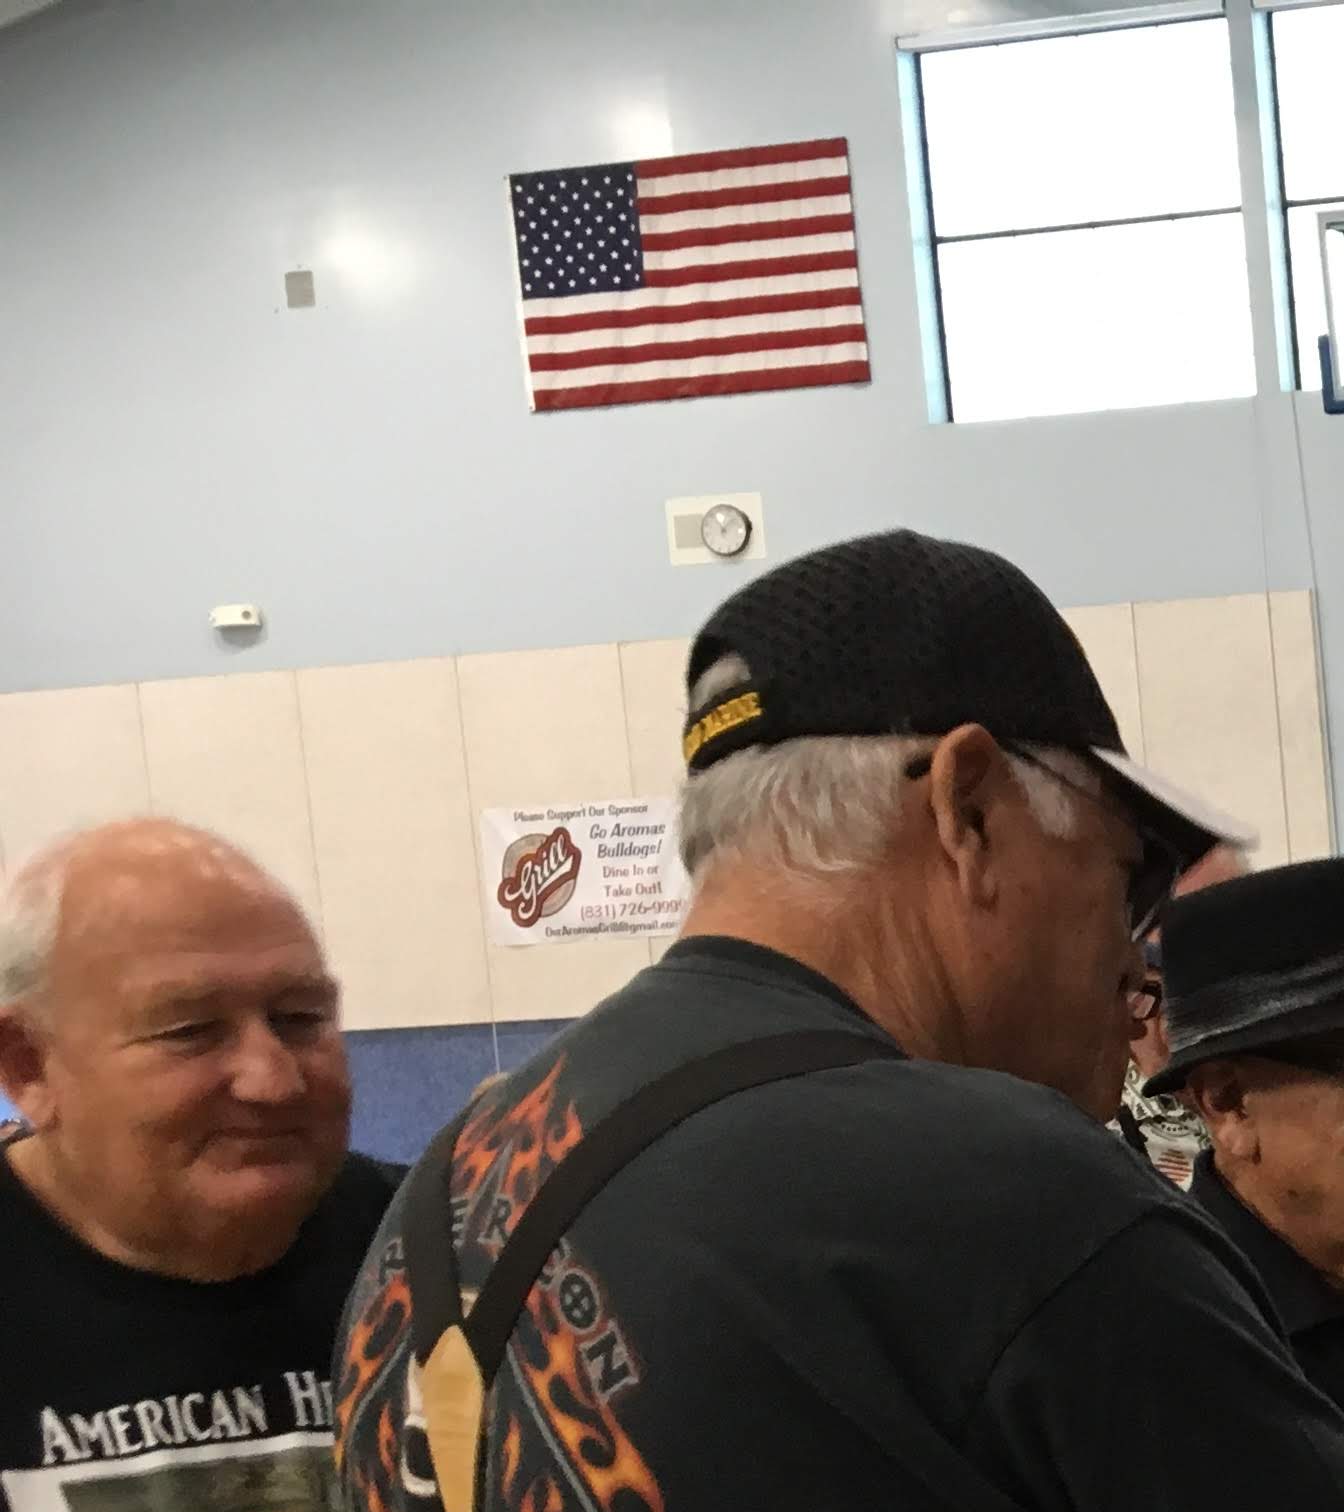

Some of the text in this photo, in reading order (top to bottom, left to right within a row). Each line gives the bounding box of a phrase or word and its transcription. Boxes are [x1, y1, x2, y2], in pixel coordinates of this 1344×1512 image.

[547, 808, 586, 822] Support
[588, 807, 605, 817] Our
[608, 804, 648, 816] Sponsor
[589, 822, 666, 839] Go Aromas
[597, 839, 663, 859] Bulldogs!
[504, 834, 574, 919] Grill
[602, 864, 659, 879] Dine In or
[603, 884, 632, 897] Take
[580, 902, 616, 922] (831)
[40, 1384, 269, 1466] AMERICAN
